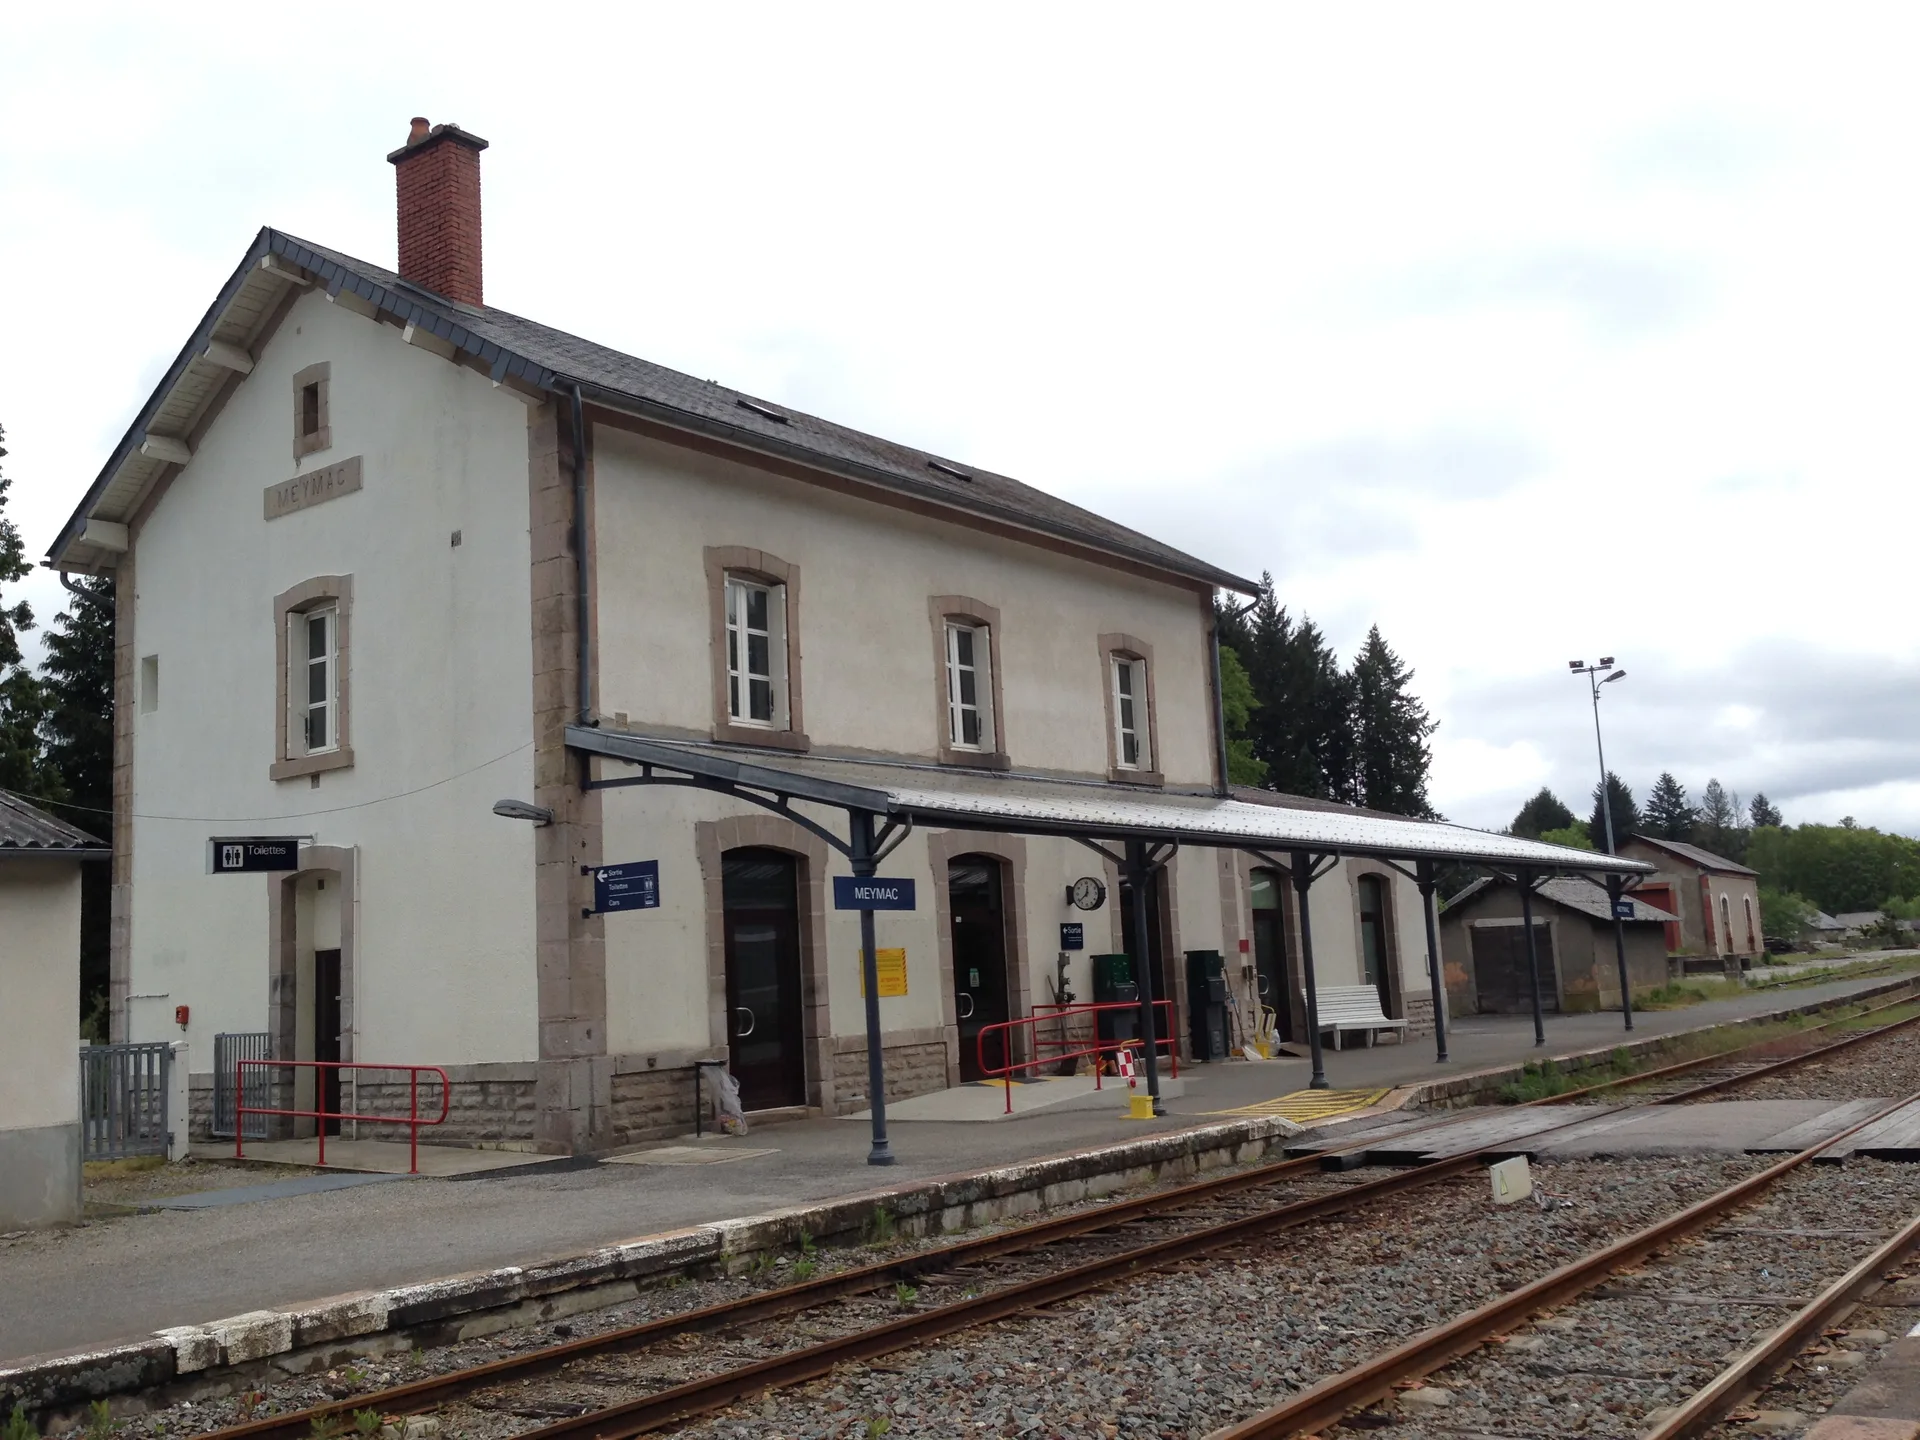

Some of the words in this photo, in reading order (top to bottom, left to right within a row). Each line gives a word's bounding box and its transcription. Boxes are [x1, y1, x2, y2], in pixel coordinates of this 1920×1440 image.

[277, 467, 345, 508] MEYMAC
[247, 845, 286, 855] Toilettes
[608, 869, 623, 877] Sortie
[854, 887, 899, 900] MEYMAC
[1067, 926, 1082, 934] Sortie
